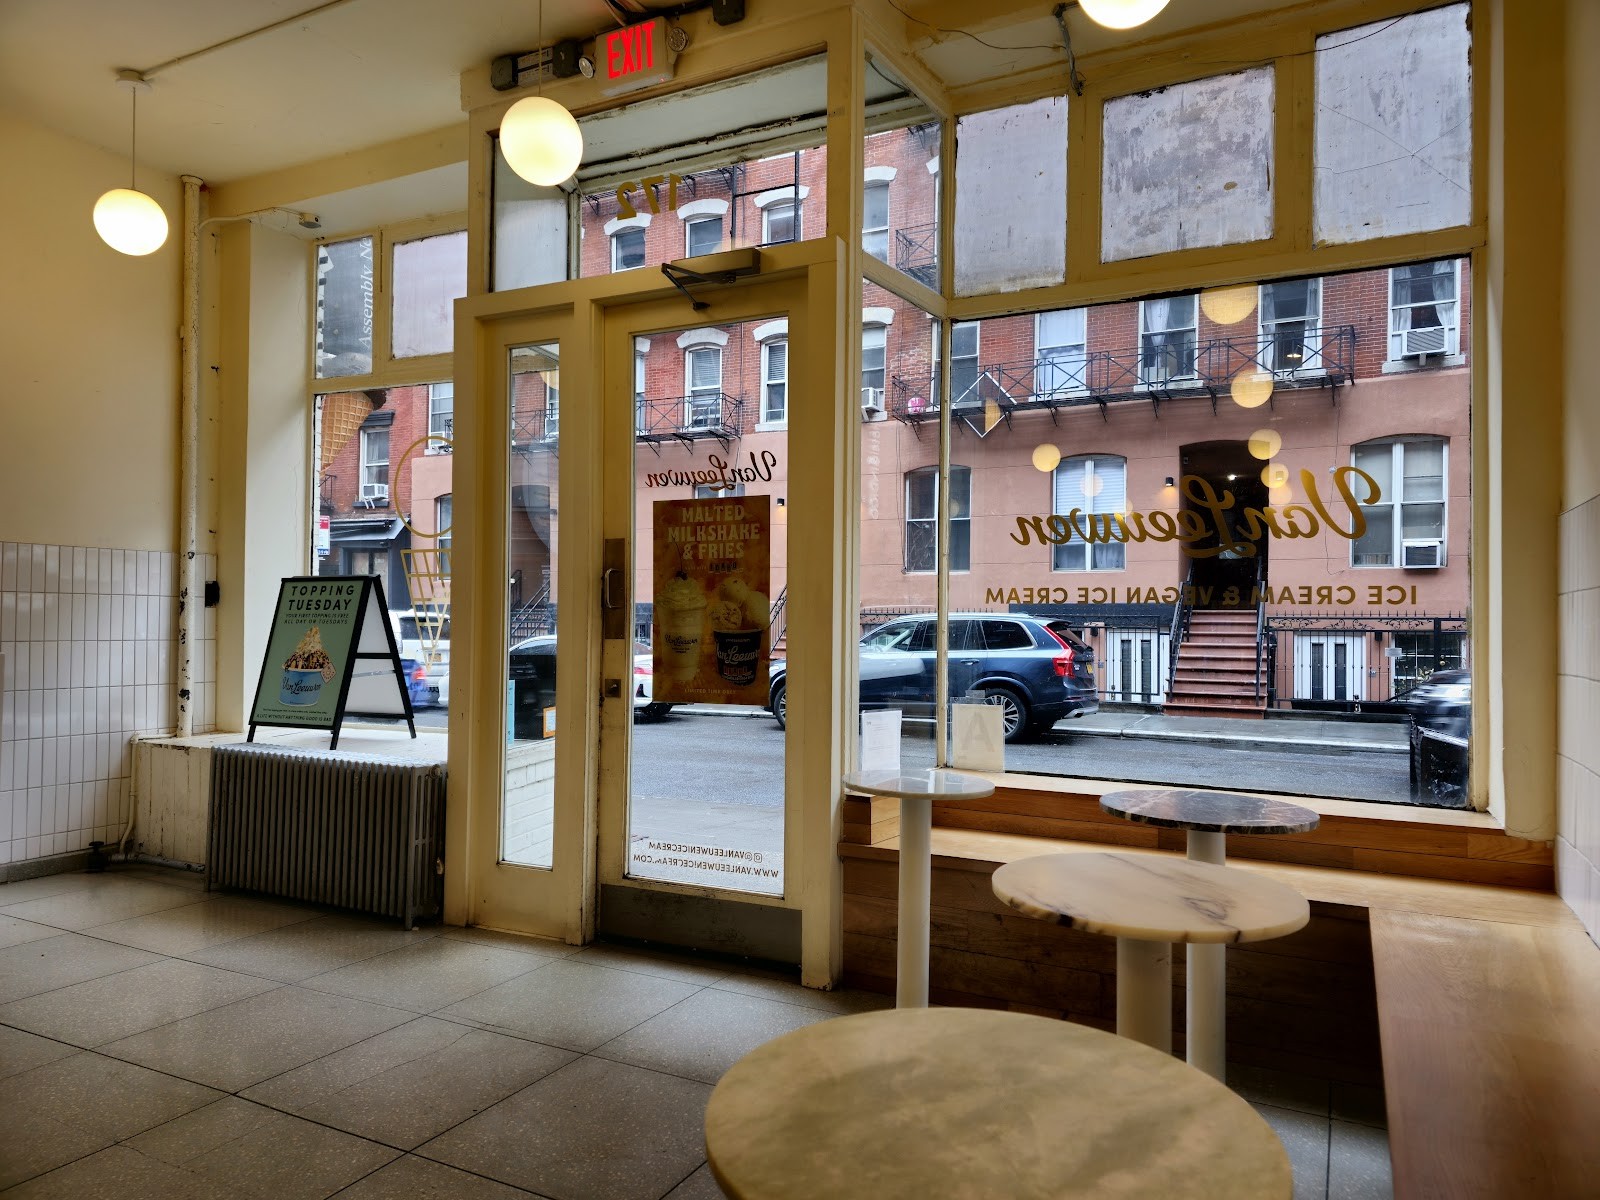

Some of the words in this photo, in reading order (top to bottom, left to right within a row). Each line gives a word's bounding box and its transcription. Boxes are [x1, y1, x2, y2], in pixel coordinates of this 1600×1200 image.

[606, 21, 656, 80] EXIT
[682, 505, 745, 523] MALTED
[668, 524, 760, 542] MILKSHAKE
[682, 544, 694, 560] &
[698, 542, 744, 560] FRIES
[292, 585, 354, 596] TOPPING
[288, 599, 352, 610] TUESDAY
